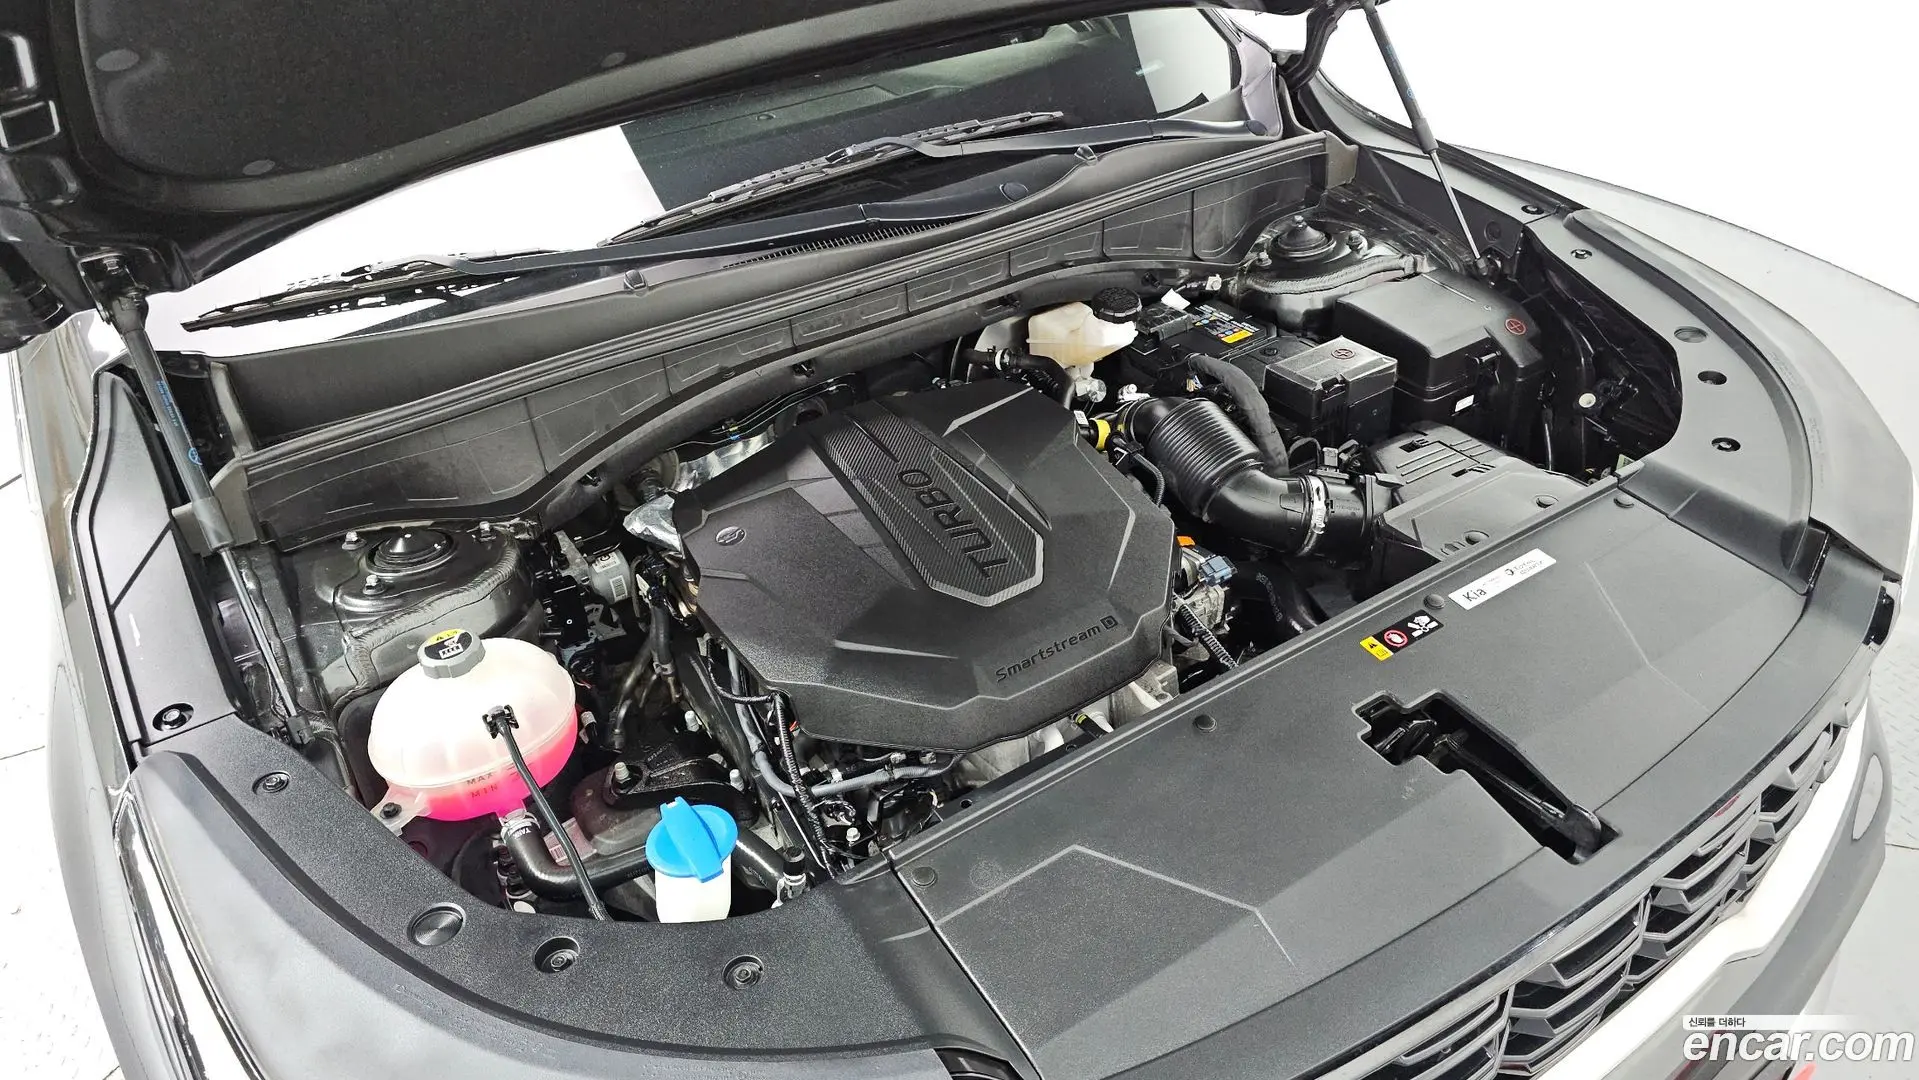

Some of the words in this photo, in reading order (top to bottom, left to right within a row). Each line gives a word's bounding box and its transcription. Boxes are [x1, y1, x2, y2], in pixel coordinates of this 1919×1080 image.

[899, 469, 1009, 580] TURBO
[1462, 588, 1487, 602] Kia
[995, 625, 1100, 682] Smartstream
[466, 772, 493, 785] MAX
[470, 784, 498, 798] MIN
